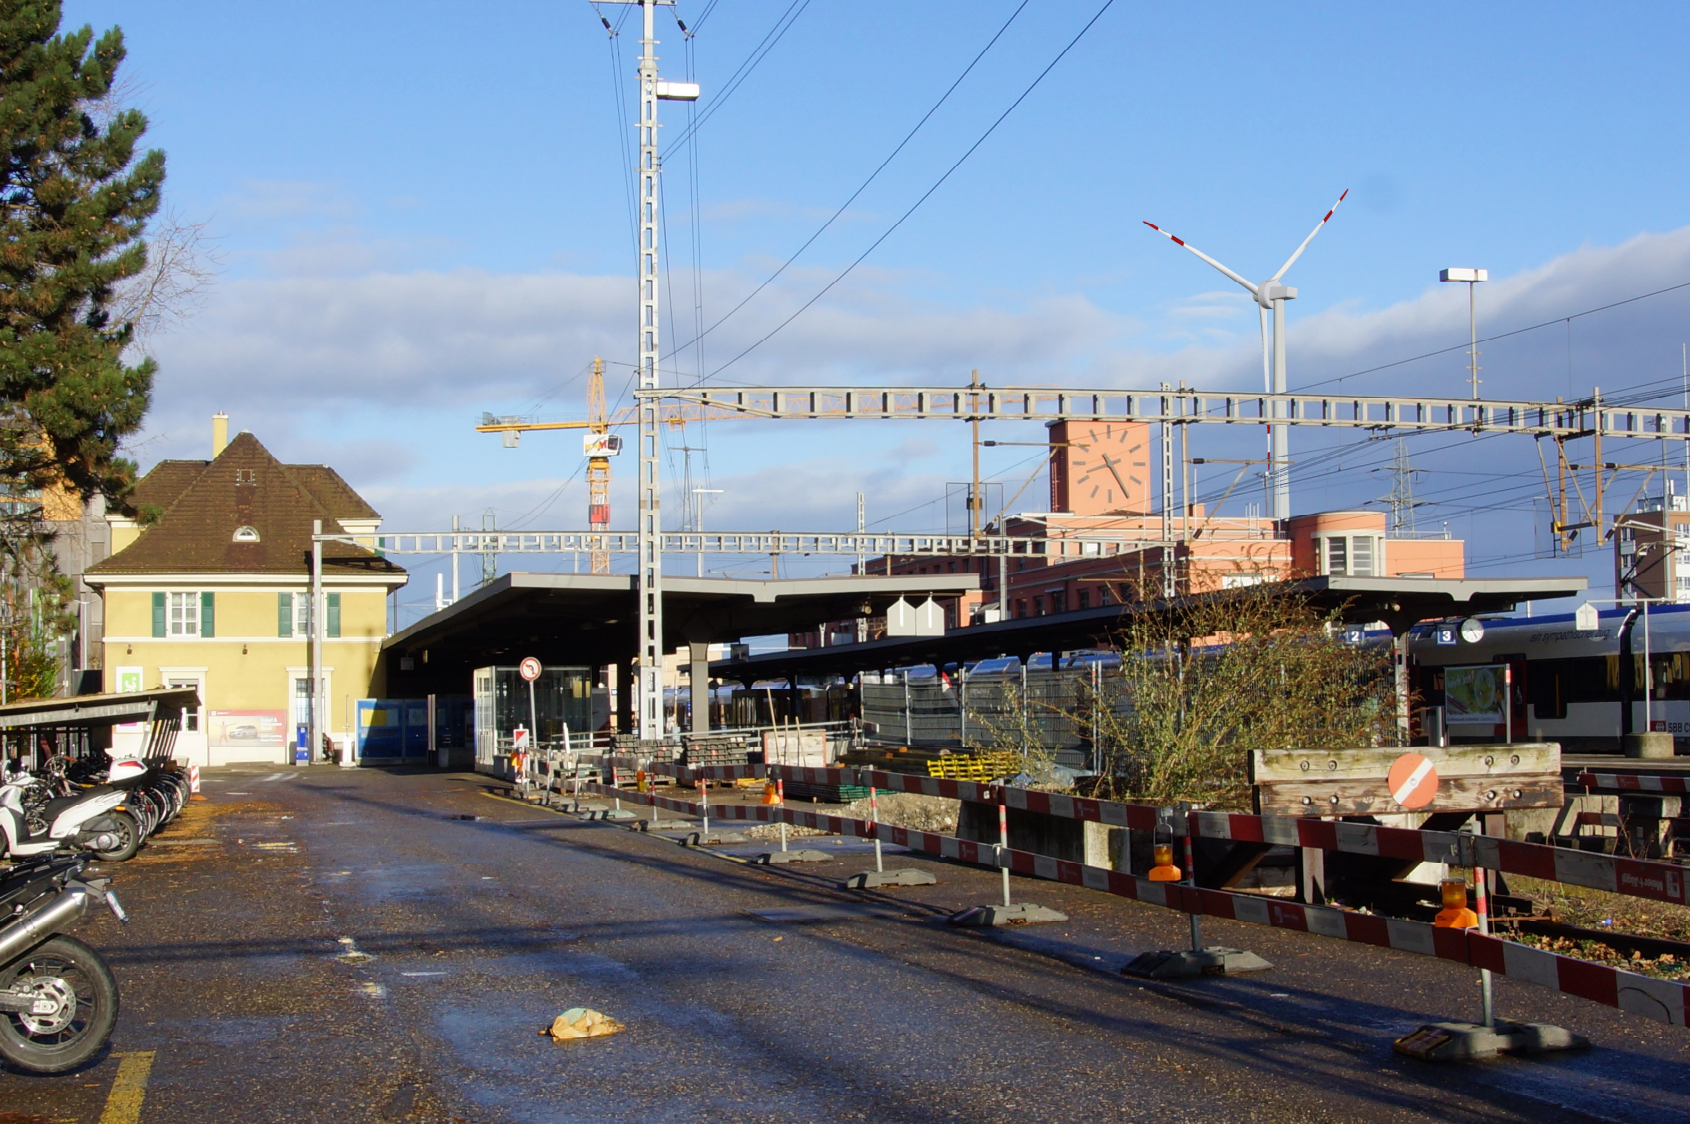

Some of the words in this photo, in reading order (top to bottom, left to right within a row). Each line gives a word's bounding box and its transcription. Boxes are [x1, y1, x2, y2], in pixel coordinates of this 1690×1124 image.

[1351, 631, 1359, 642] 2
[1442, 630, 1451, 641] 3
[1668, 722, 1683, 733] SBB
